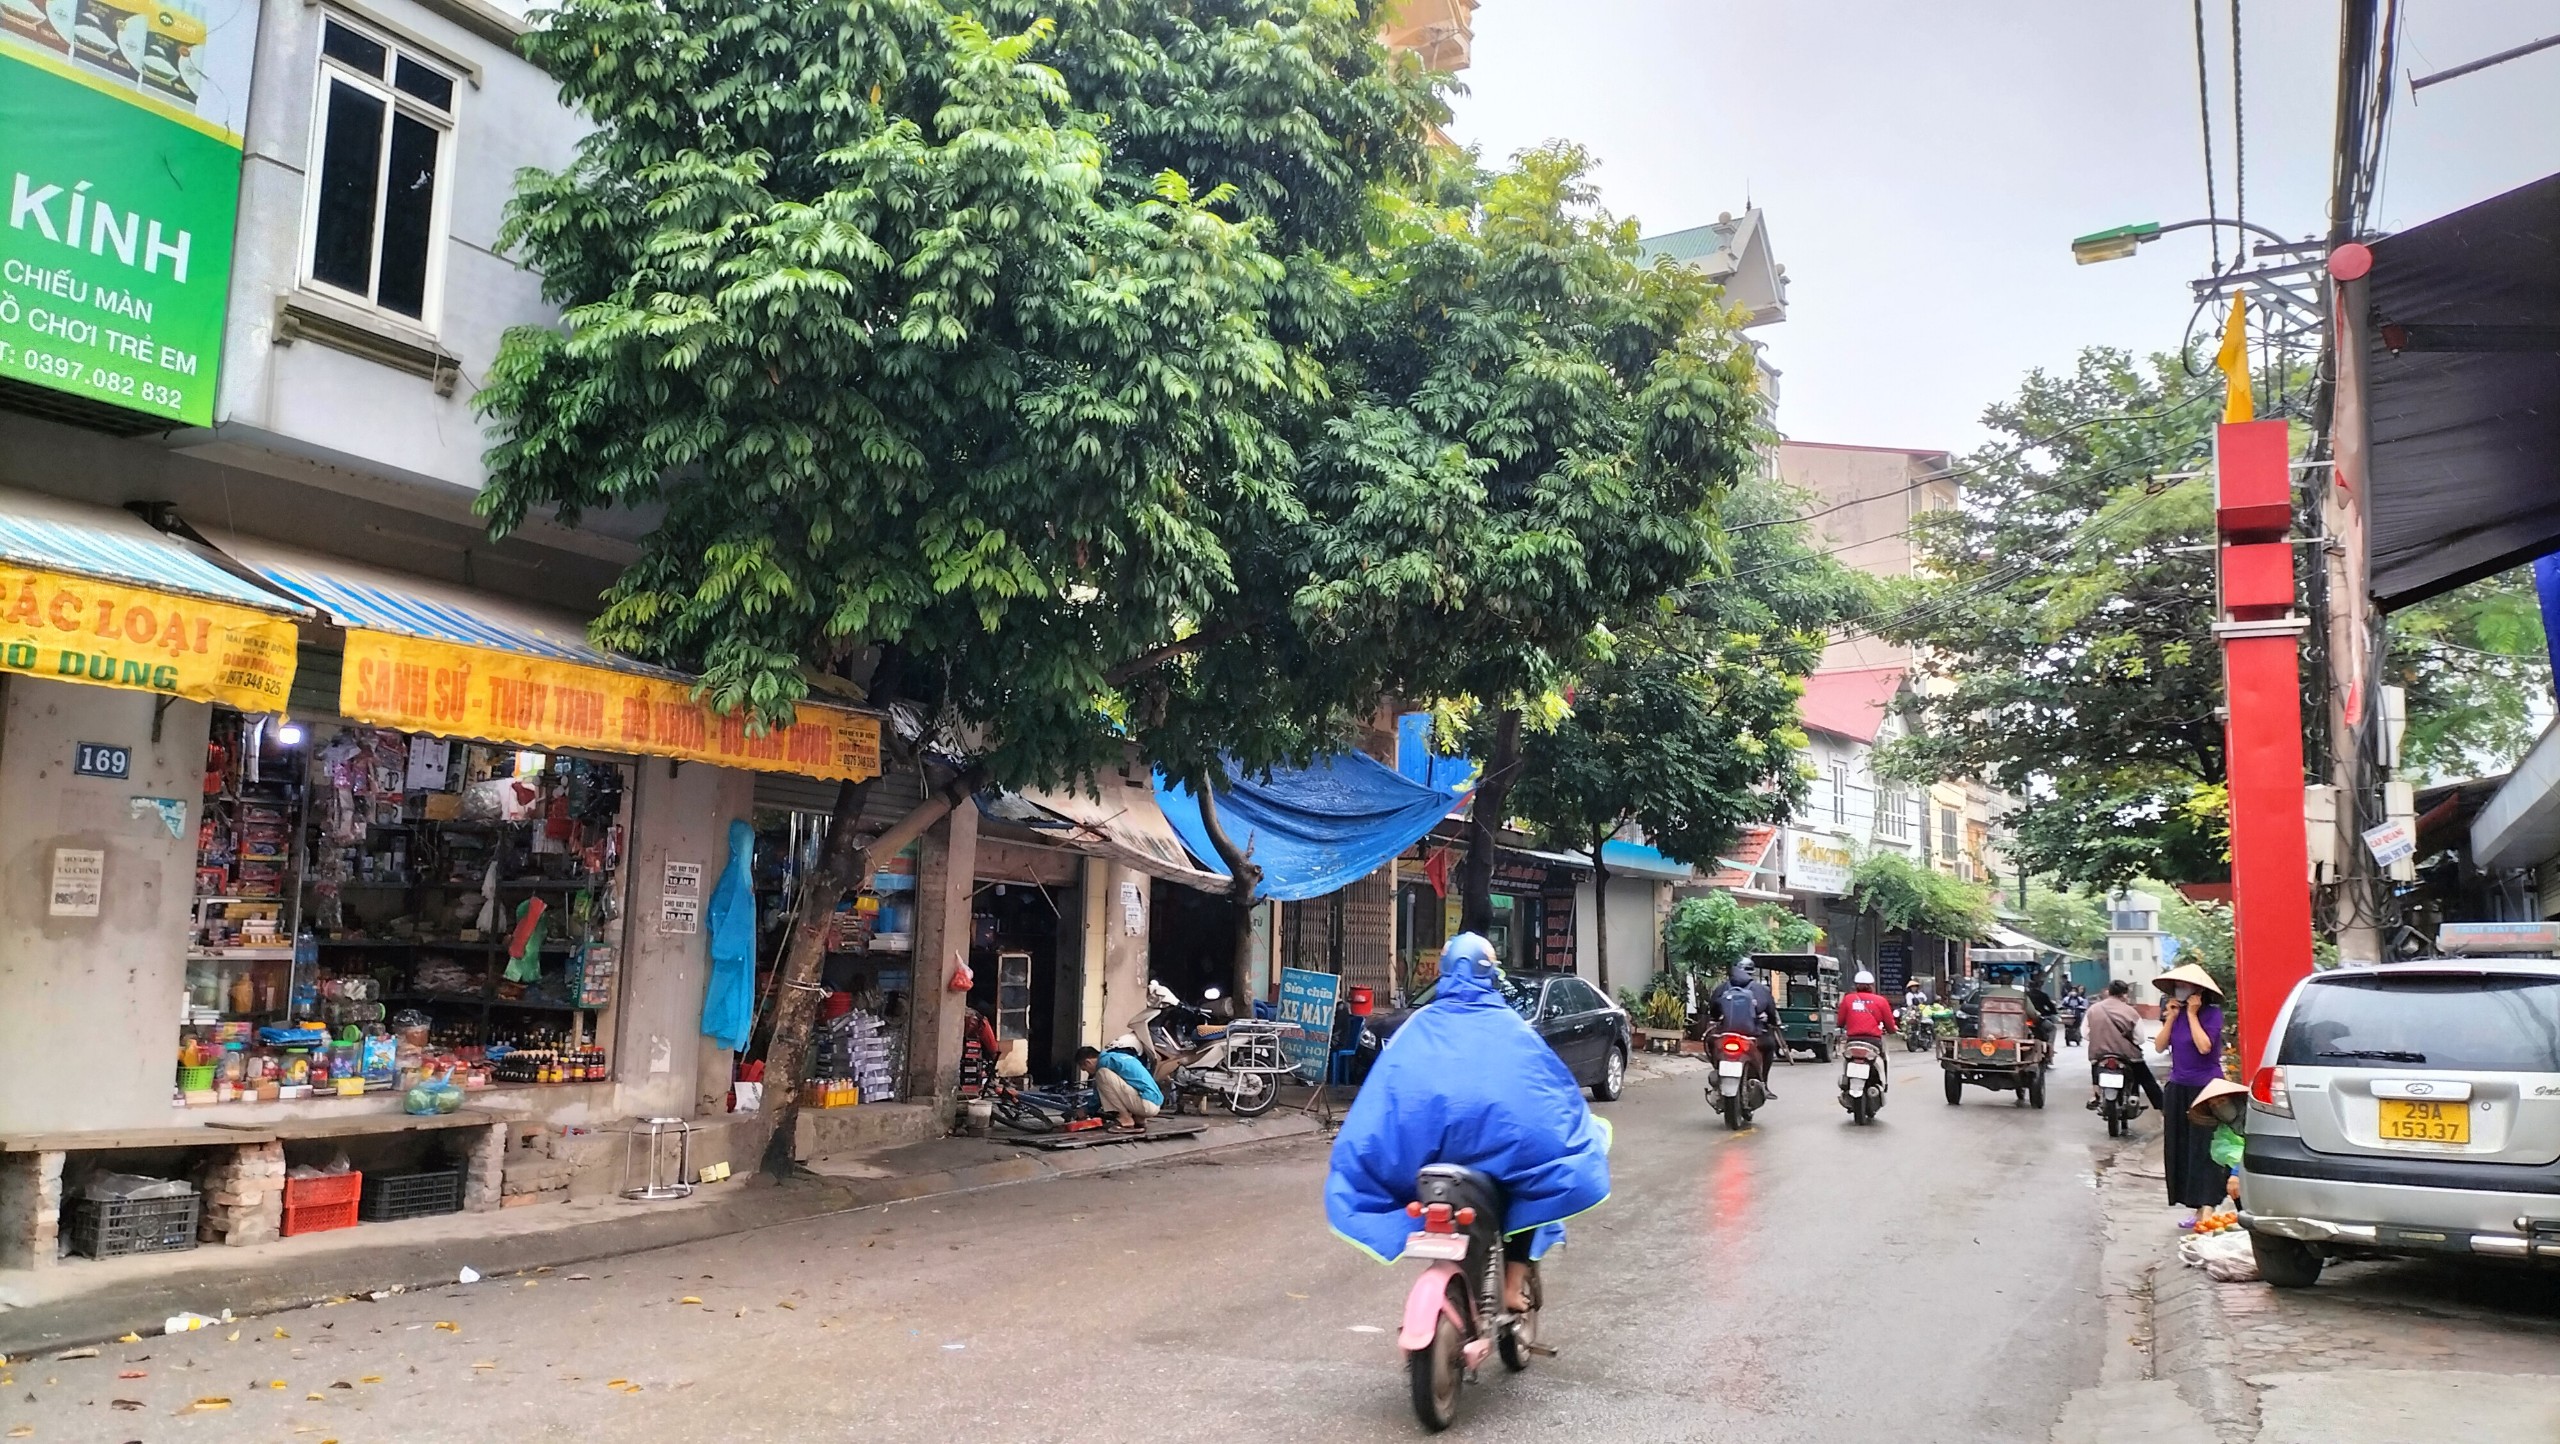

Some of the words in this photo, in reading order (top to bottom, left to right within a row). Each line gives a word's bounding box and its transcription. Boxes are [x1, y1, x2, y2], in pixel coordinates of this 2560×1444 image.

[10, 172, 191, 283] KÍNH
[95, 286, 153, 324] MÀN
[28, 308, 98, 347] CHƠI
[105, 329, 155, 364] TRẺ
[160, 346, 197, 376] EM
[24, 349, 135, 396] 0397.082
[141, 381, 182, 409] 832
[95, 600, 212, 657] LOẠI
[0, 634, 37, 669] Ồ
[59, 649, 180, 691] DÙNG
[244, 672, 263, 689] 348
[264, 678, 281, 695] 525
[356, 648, 428, 717] SÀNH
[434, 658, 472, 722] SỨ
[488, 667, 549, 732] THỦY
[554, 686, 604, 739] TINH
[81, 748, 126, 773] 169
[1281, 999, 1299, 1021] XE
[1301, 998, 1332, 1026] MÁY
[2391, 1121, 2459, 1141] 153.37
[2405, 1102, 2443, 1121] 29A
